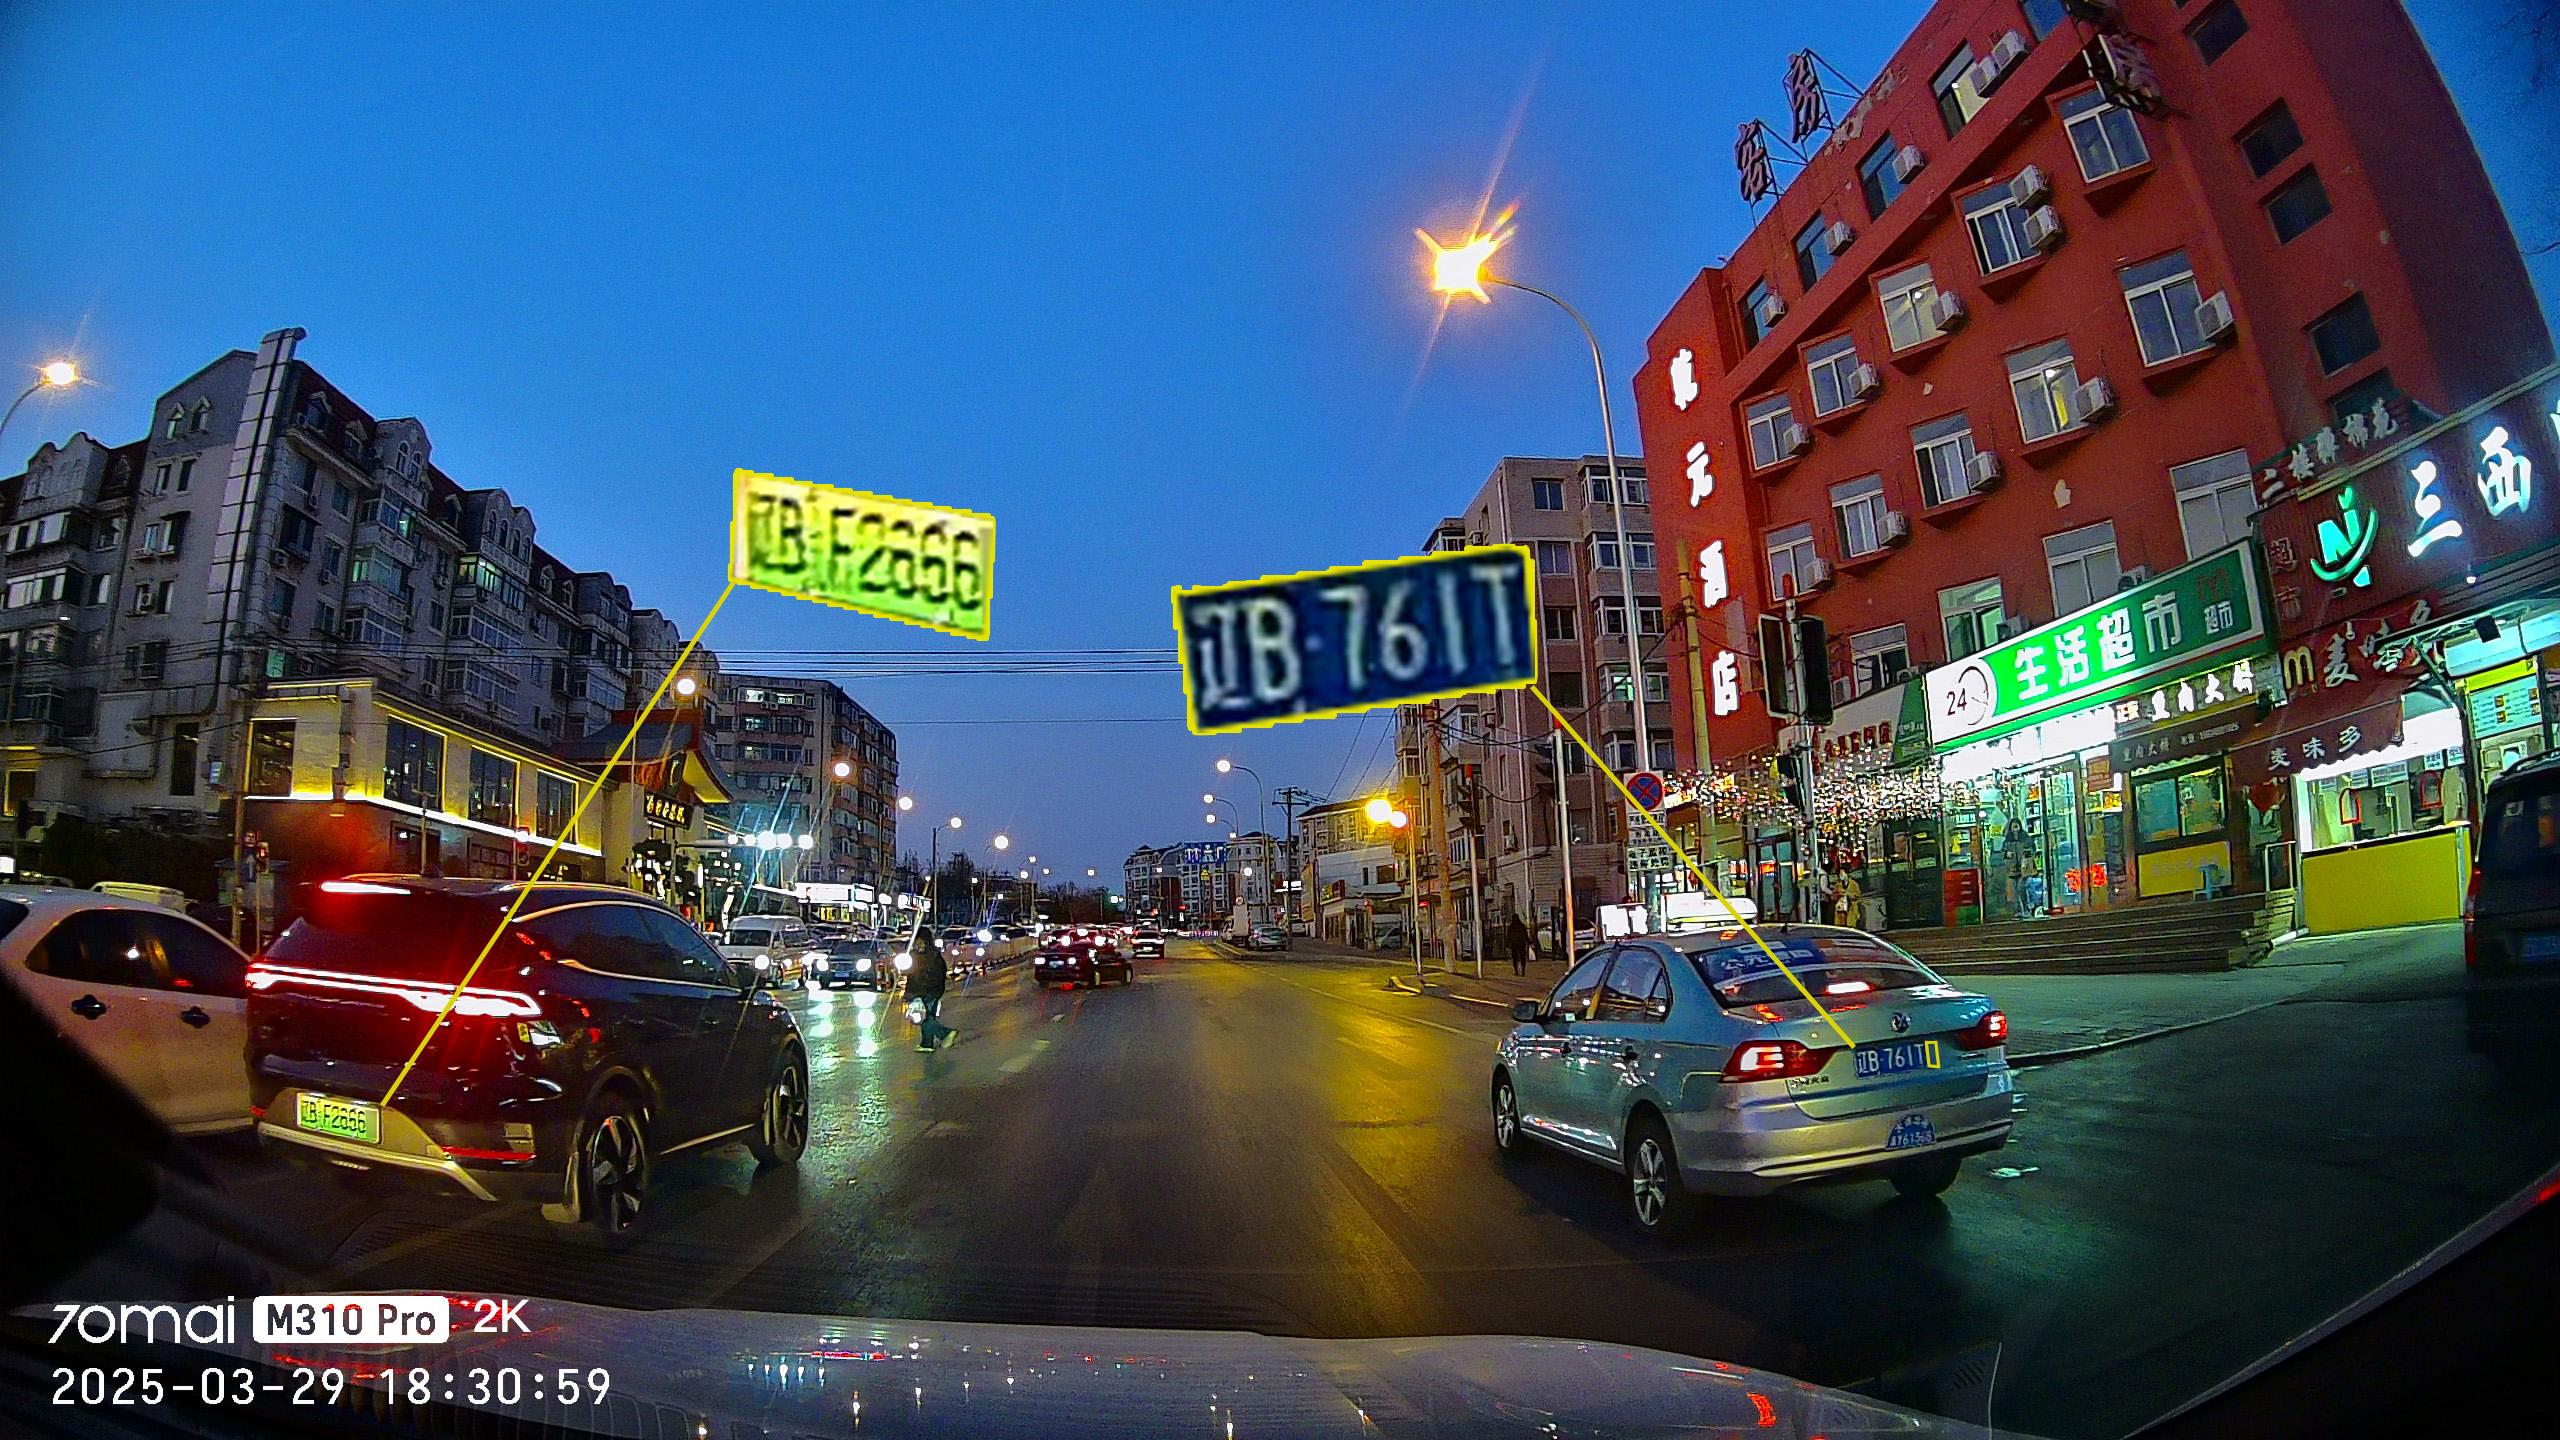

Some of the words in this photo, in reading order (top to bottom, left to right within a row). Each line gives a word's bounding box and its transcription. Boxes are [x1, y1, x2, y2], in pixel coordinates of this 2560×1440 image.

[2203, 600, 2234, 635] 超市
[2013, 590, 2183, 702] 生活超市
[1946, 687, 1968, 716] 24
[2268, 725, 2363, 772] 麦味多
